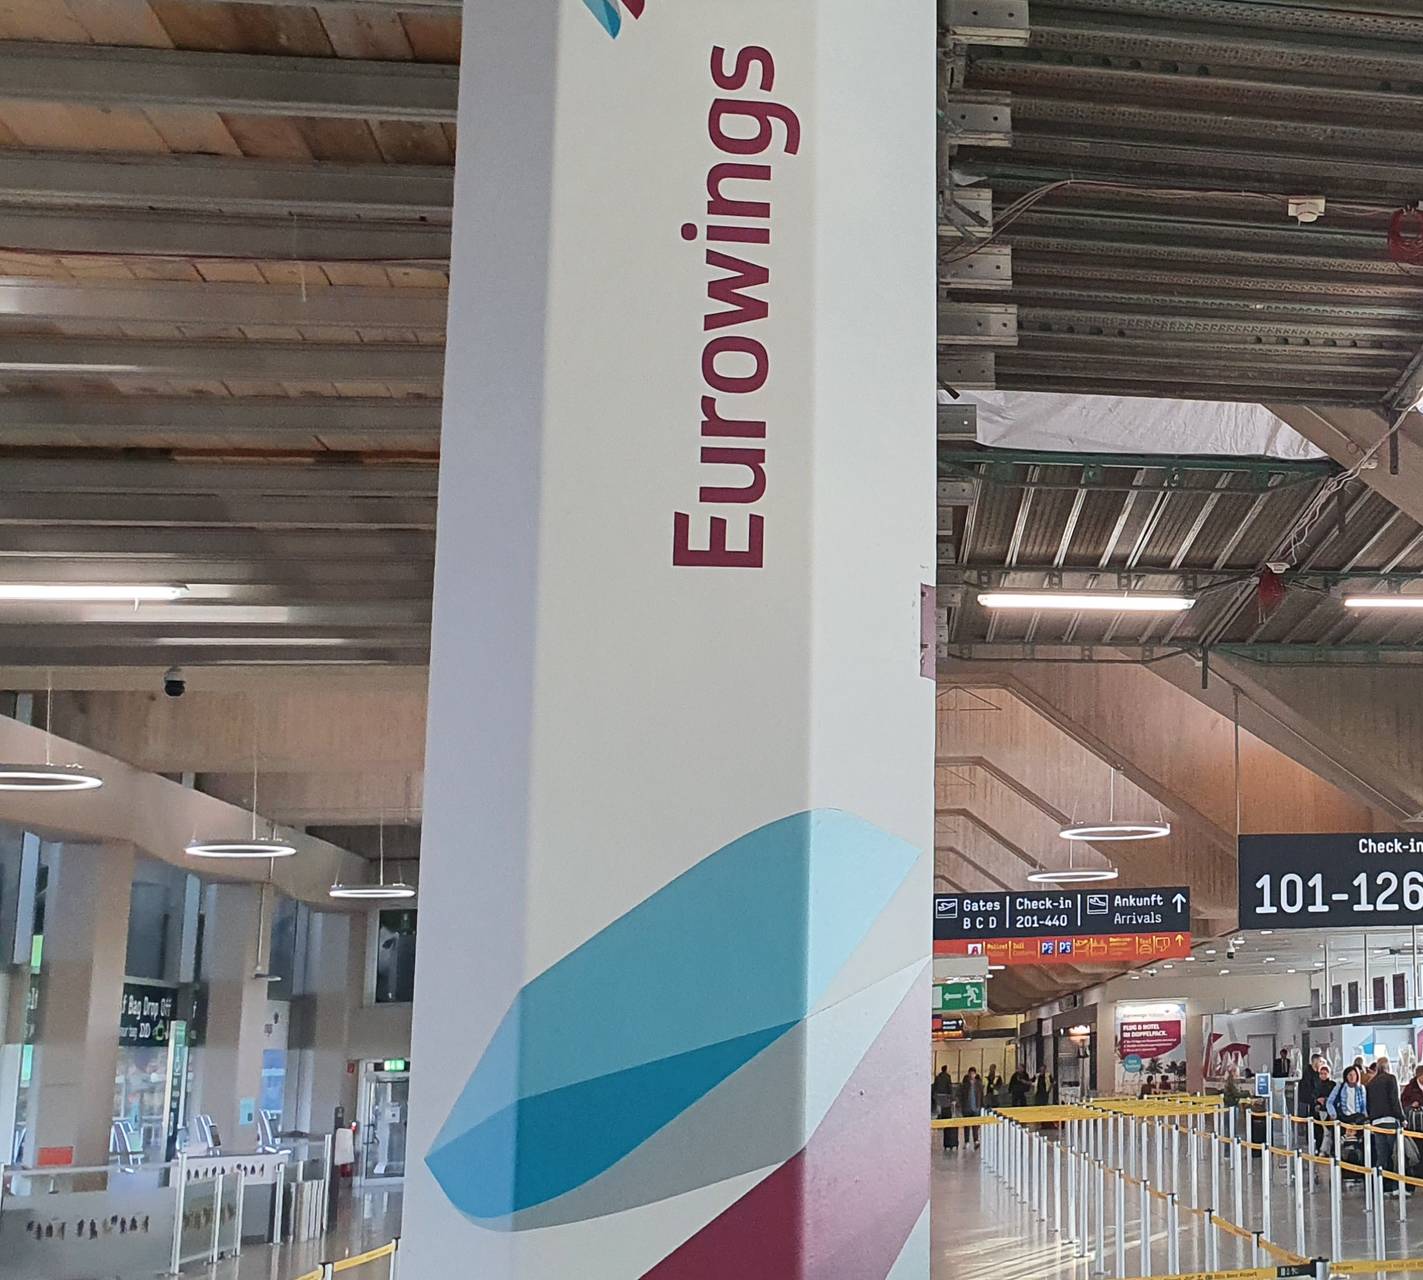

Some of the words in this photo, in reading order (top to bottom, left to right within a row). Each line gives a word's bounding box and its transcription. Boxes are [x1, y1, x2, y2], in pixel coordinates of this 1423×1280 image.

[673, 45, 801, 568] Eurowings
[963, 898, 1001, 912] Gates
[1016, 897, 1072, 911] Check-in
[1114, 894, 1164, 908] Ankunft
[963, 917, 971, 929] B
[976, 917, 984, 929] C
[989, 916, 997, 929] D
[1016, 914, 1068, 928] 201-440
[1114, 912, 1162, 925] Arrivals
